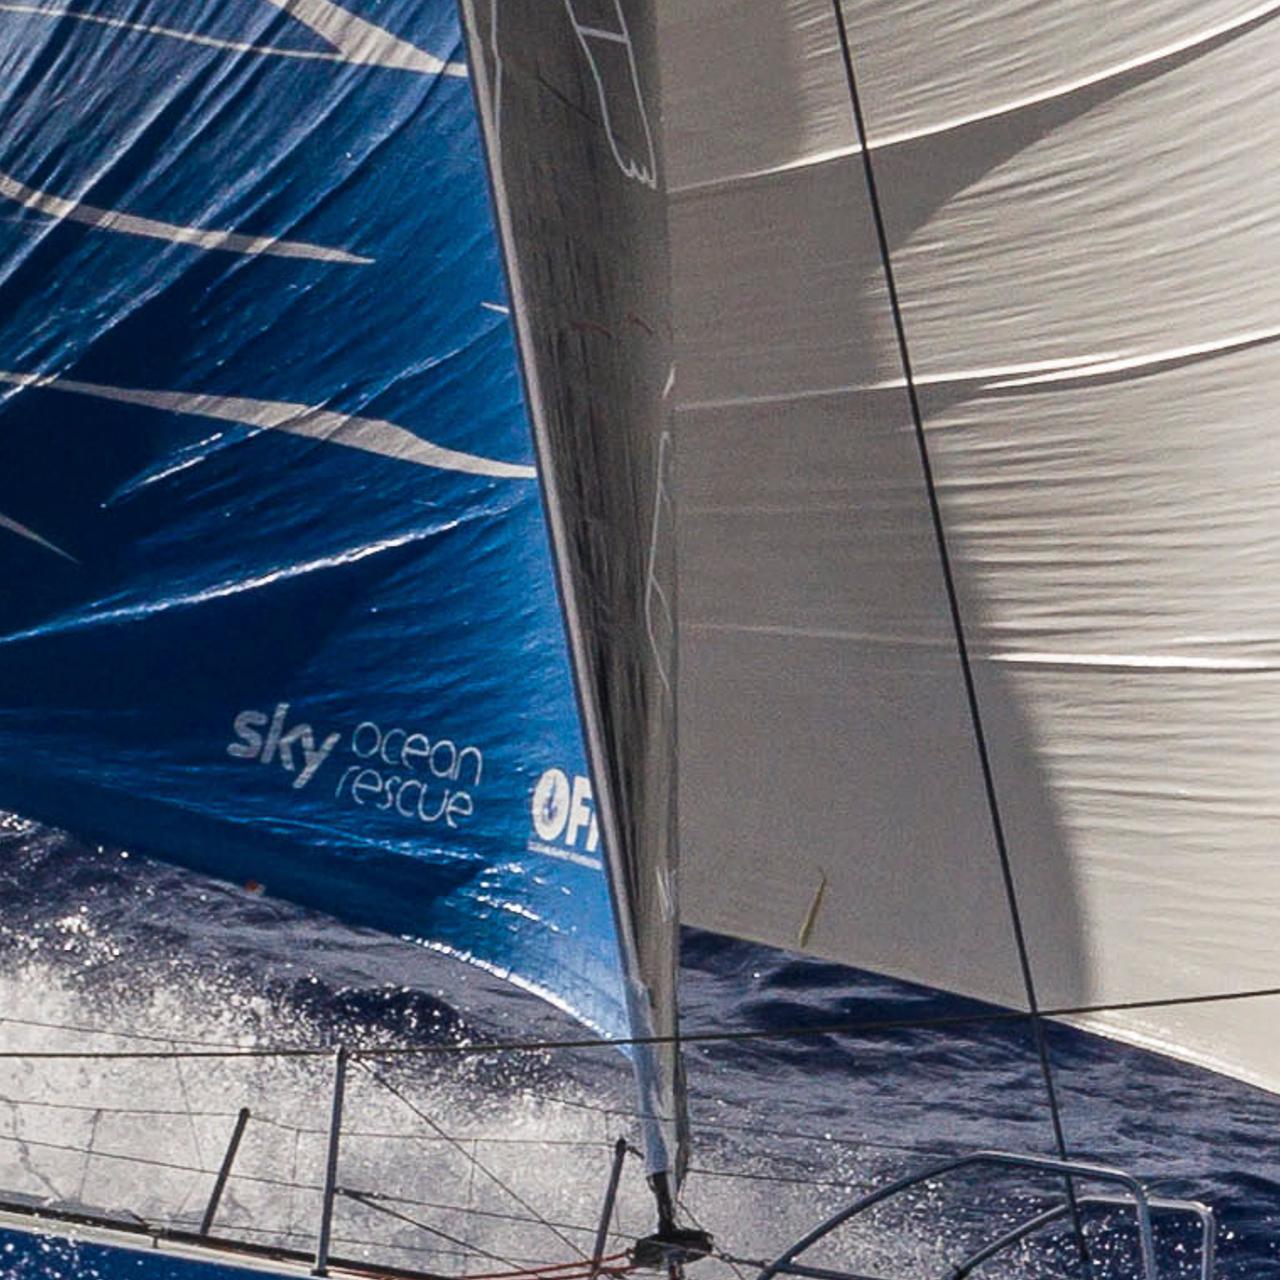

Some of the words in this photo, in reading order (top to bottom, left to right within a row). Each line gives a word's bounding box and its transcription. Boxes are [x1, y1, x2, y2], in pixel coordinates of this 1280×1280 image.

[226, 702, 341, 789] sky
[351, 721, 483, 787] ocean
[335, 765, 474, 829] rescue
